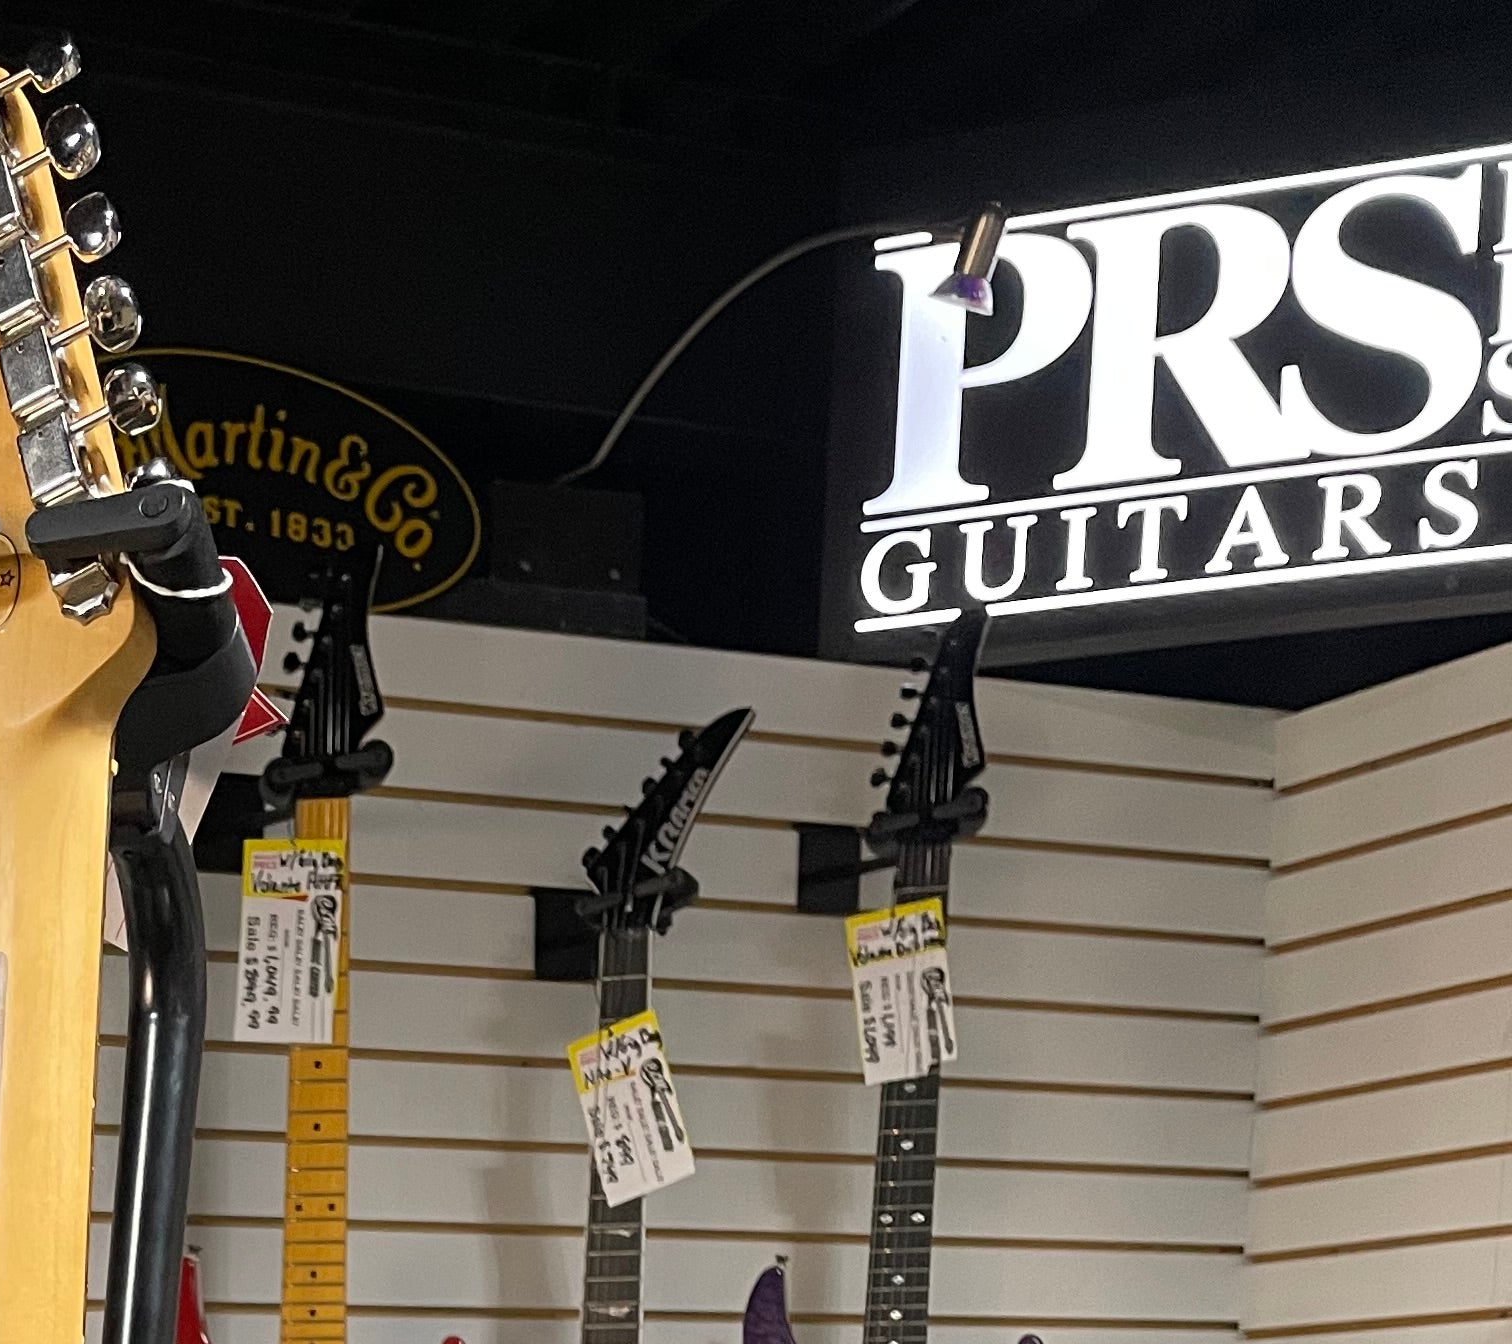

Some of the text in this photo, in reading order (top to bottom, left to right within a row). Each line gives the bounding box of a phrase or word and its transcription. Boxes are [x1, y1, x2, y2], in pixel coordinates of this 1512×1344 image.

[863, 163, 1483, 516] PRS
[859, 457, 1480, 616] GUITARS
[247, 916, 260, 951] Sale
